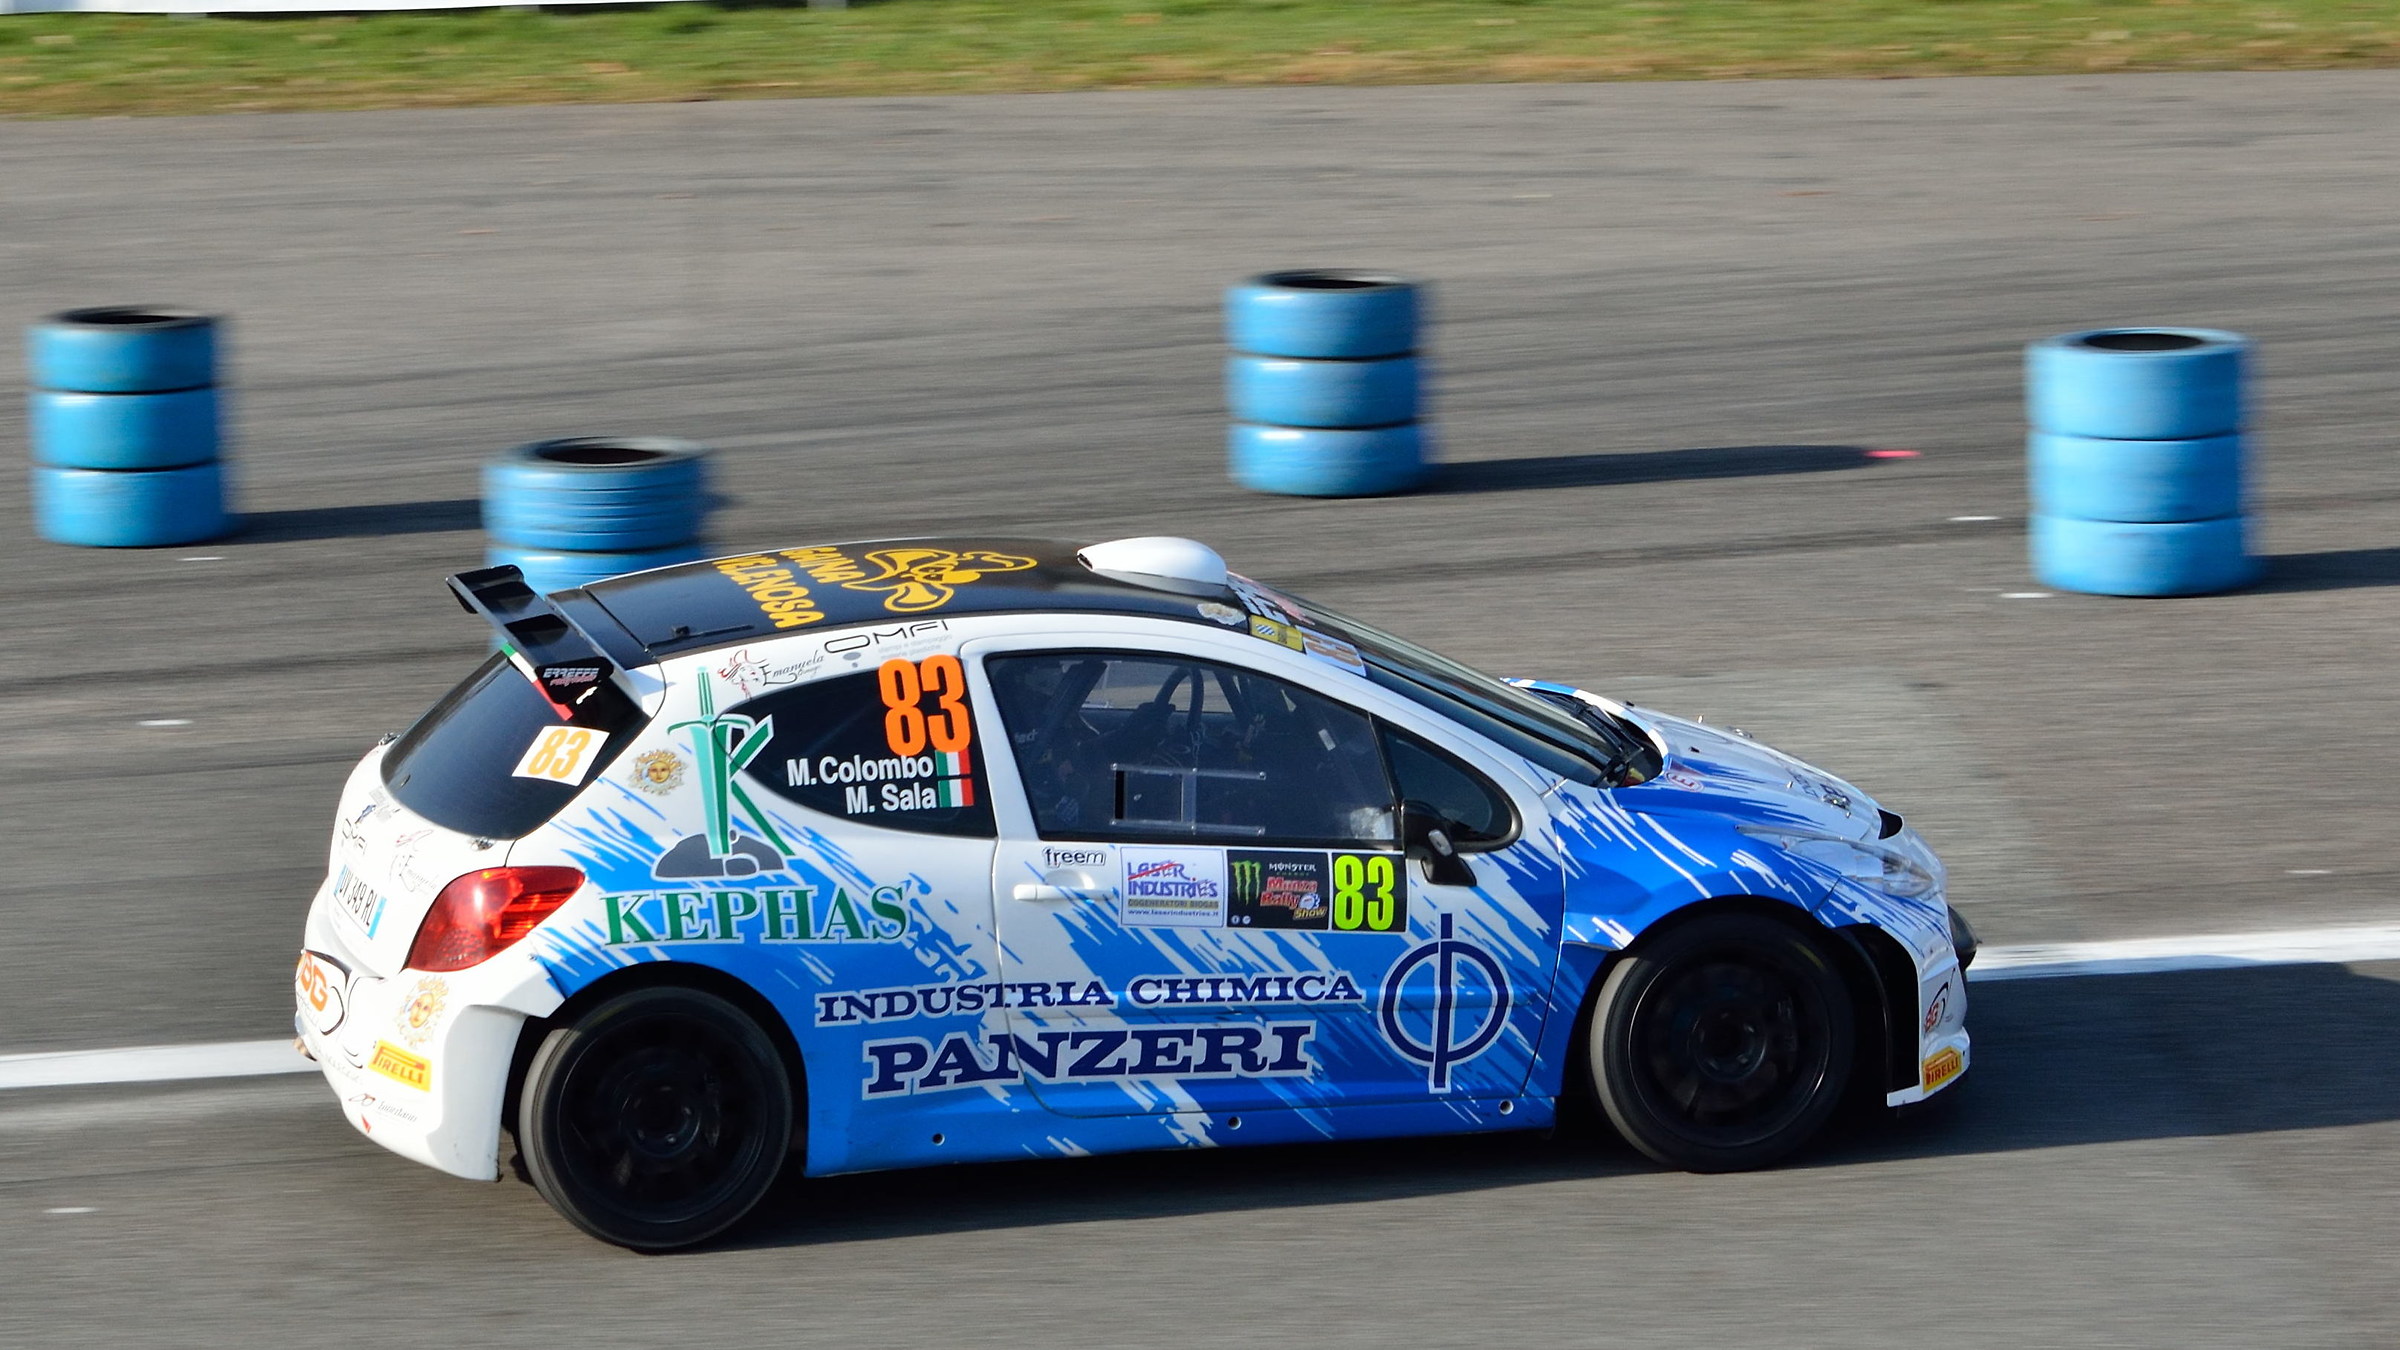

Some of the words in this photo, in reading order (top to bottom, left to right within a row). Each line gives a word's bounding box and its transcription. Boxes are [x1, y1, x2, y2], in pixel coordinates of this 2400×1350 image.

[712, 555, 825, 628] VELENOSA
[824, 620, 949, 653] OMFI
[762, 650, 825, 686] Emanuela
[878, 654, 971, 757] 83
[527, 728, 592, 779] 83
[787, 758, 817, 786] M.
[819, 754, 934, 784] Colombo
[845, 785, 876, 814] M.
[881, 783, 937, 812] Sala
[1045, 848, 1104, 866] freem
[1127, 860, 1190, 880] LASER
[1269, 862, 1317, 873] MONSTER
[1127, 879, 1218, 898] INDUSTRIES
[1334, 855, 1394, 930] 83
[601, 886, 909, 946] KEPHAS
[819, 981, 1114, 1022] INDUSTRIA
[1130, 975, 1362, 1005] CHIMICA
[372, 1046, 426, 1085] PIRELLI
[867, 1025, 1311, 1095] PANZERI
[1924, 1051, 1960, 1086] PIRELLI
